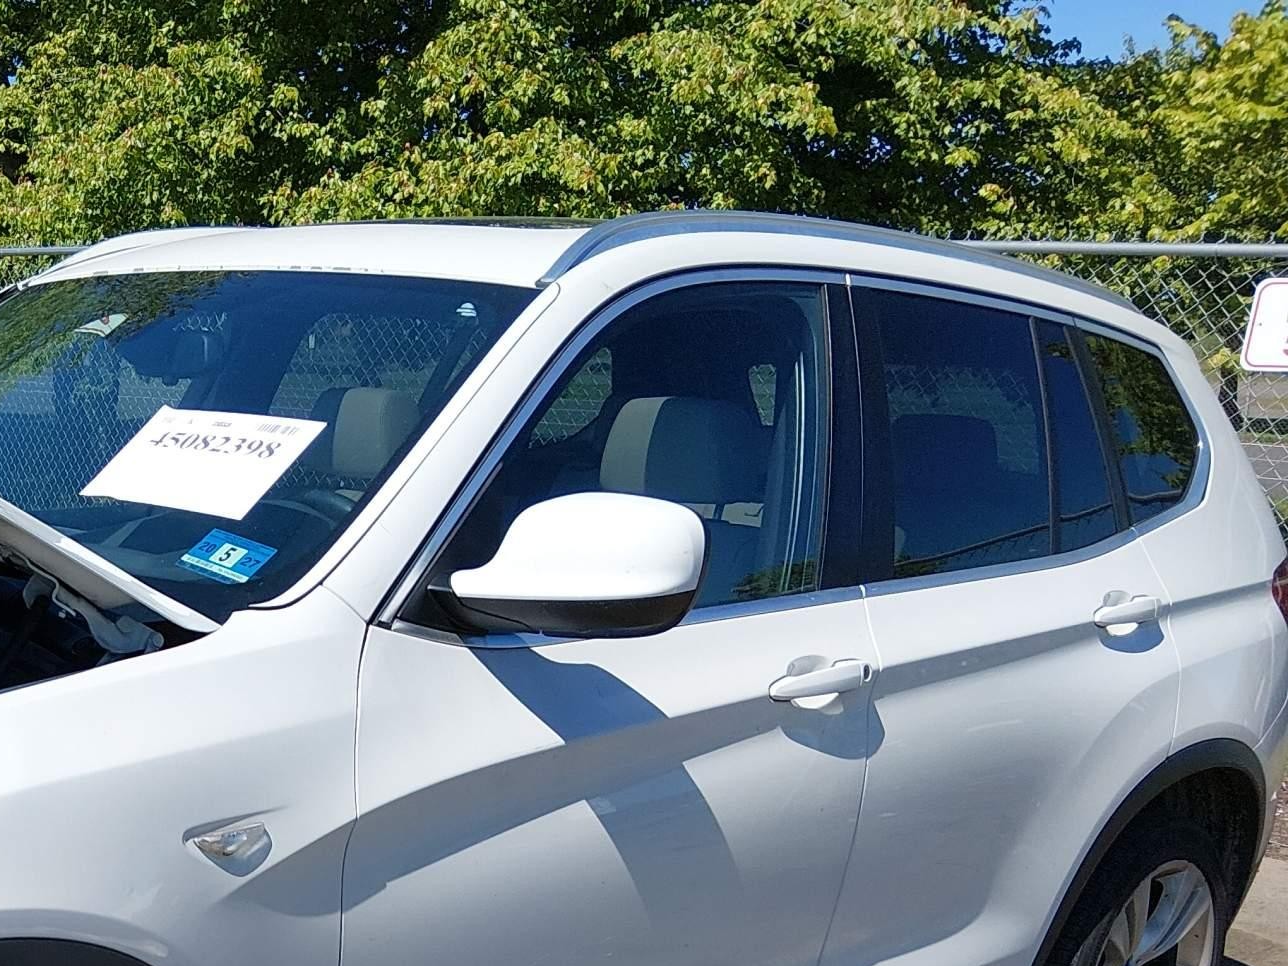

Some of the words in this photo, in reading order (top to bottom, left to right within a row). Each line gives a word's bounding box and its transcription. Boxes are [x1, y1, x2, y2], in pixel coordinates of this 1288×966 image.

[148, 431, 282, 459] 45082398
[199, 541, 217, 554] 20
[218, 547, 237, 562] 5
[240, 556, 261, 569] 27
